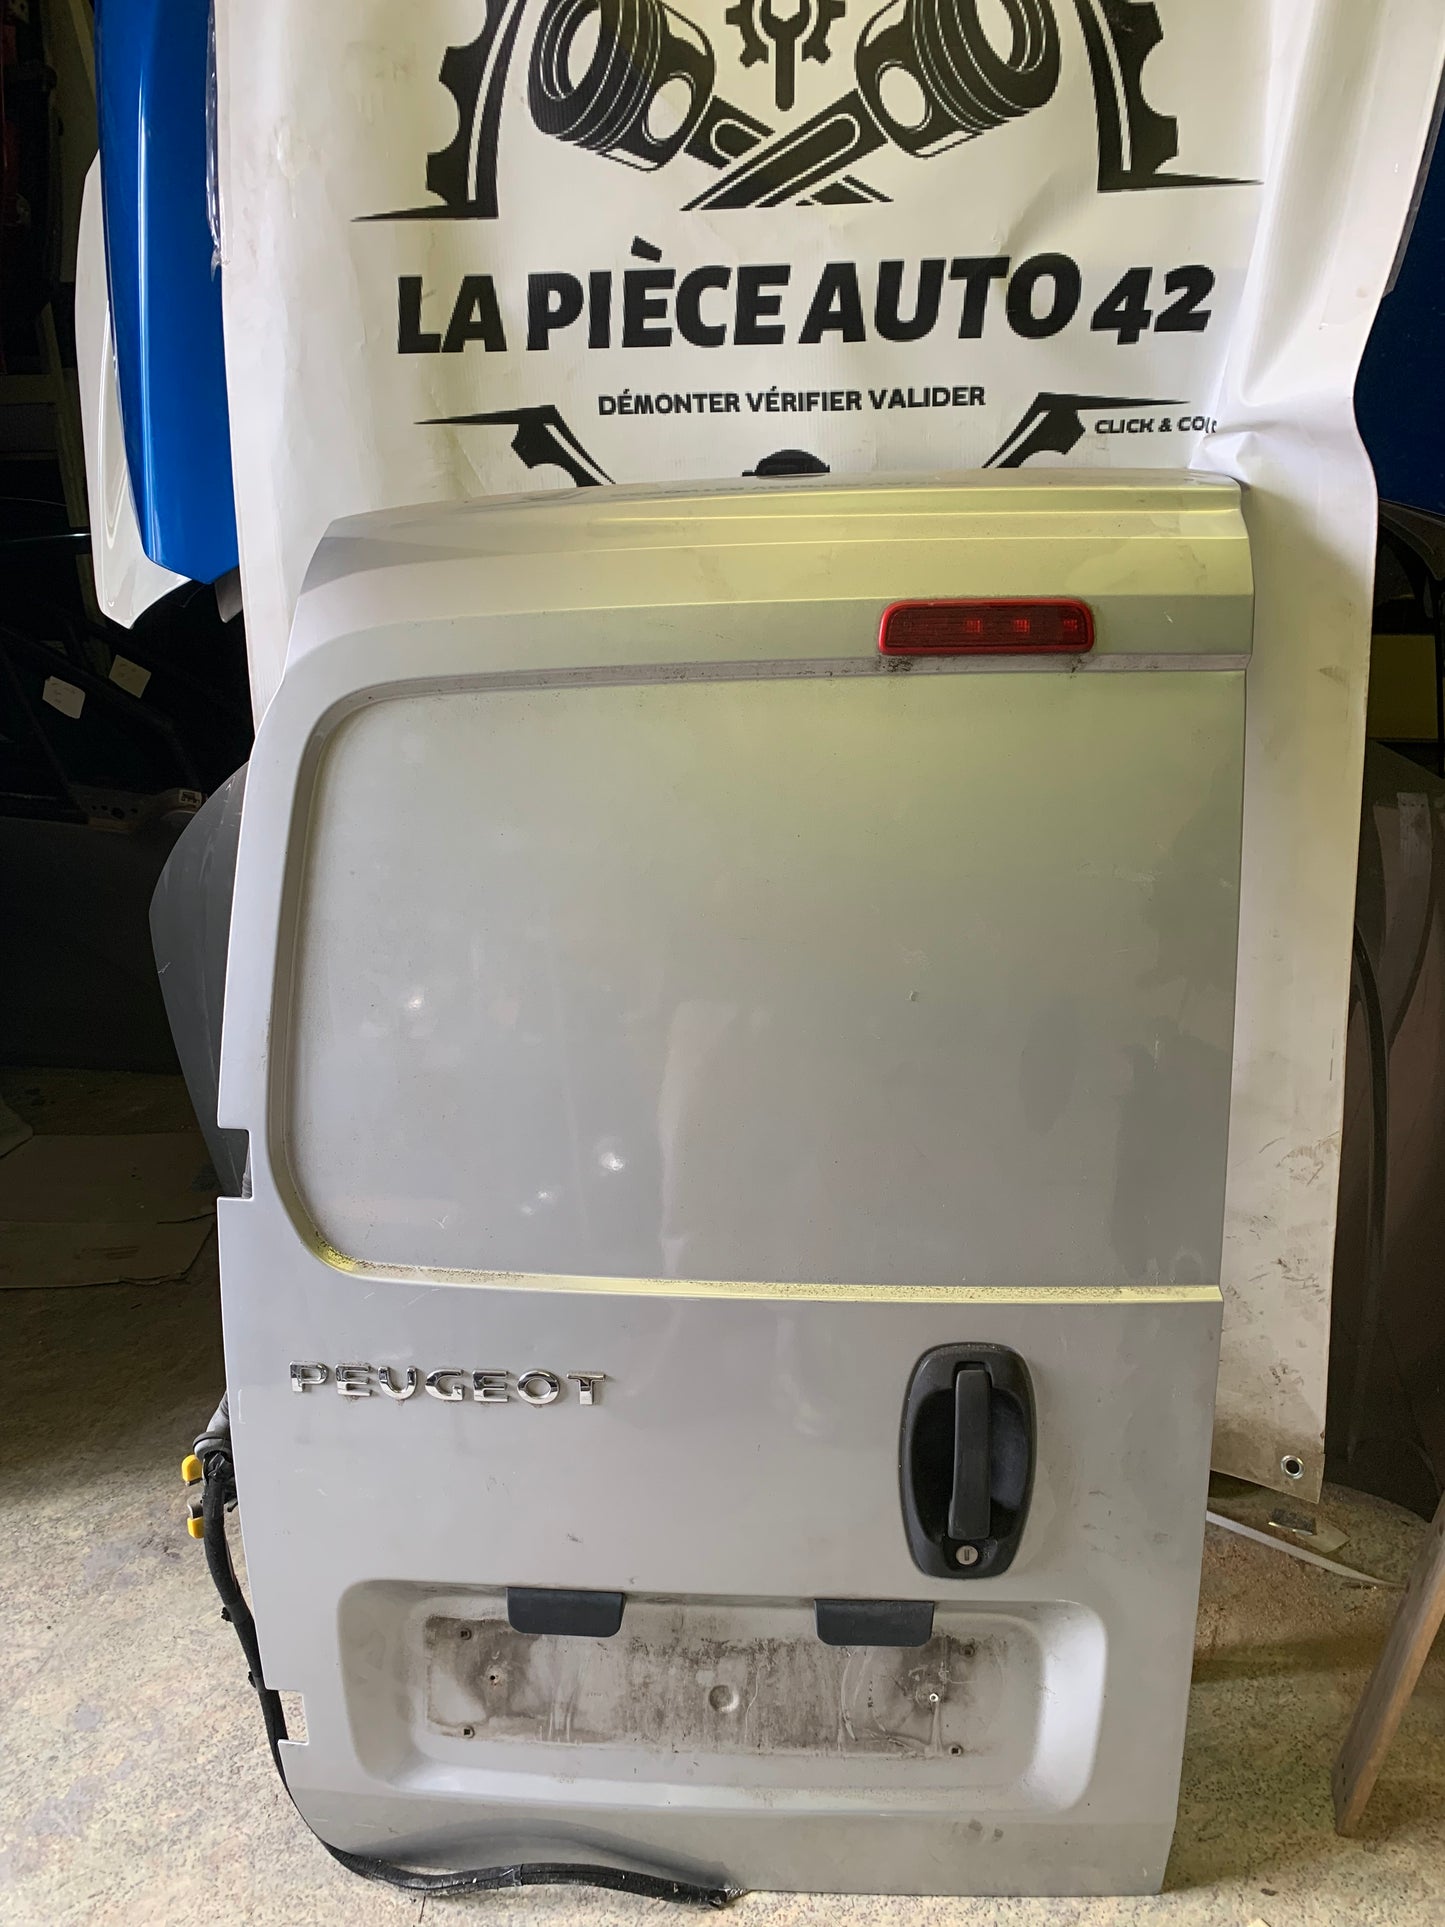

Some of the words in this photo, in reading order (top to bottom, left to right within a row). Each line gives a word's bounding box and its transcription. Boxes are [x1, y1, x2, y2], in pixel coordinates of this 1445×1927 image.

[398, 274, 507, 354] LA
[526, 235, 791, 351] PIÈCE
[798, 252, 1082, 343] AUTO
[1090, 264, 1216, 345] 42
[599, 388, 741, 416] DÉMONTER
[745, 385, 862, 412] VÉRIFIER
[868, 386, 985, 410] VALIDER
[1095, 418, 1154, 434] CLICK
[1158, 417, 1172, 432] &
[289, 1360, 607, 1405] PEUGEOT
